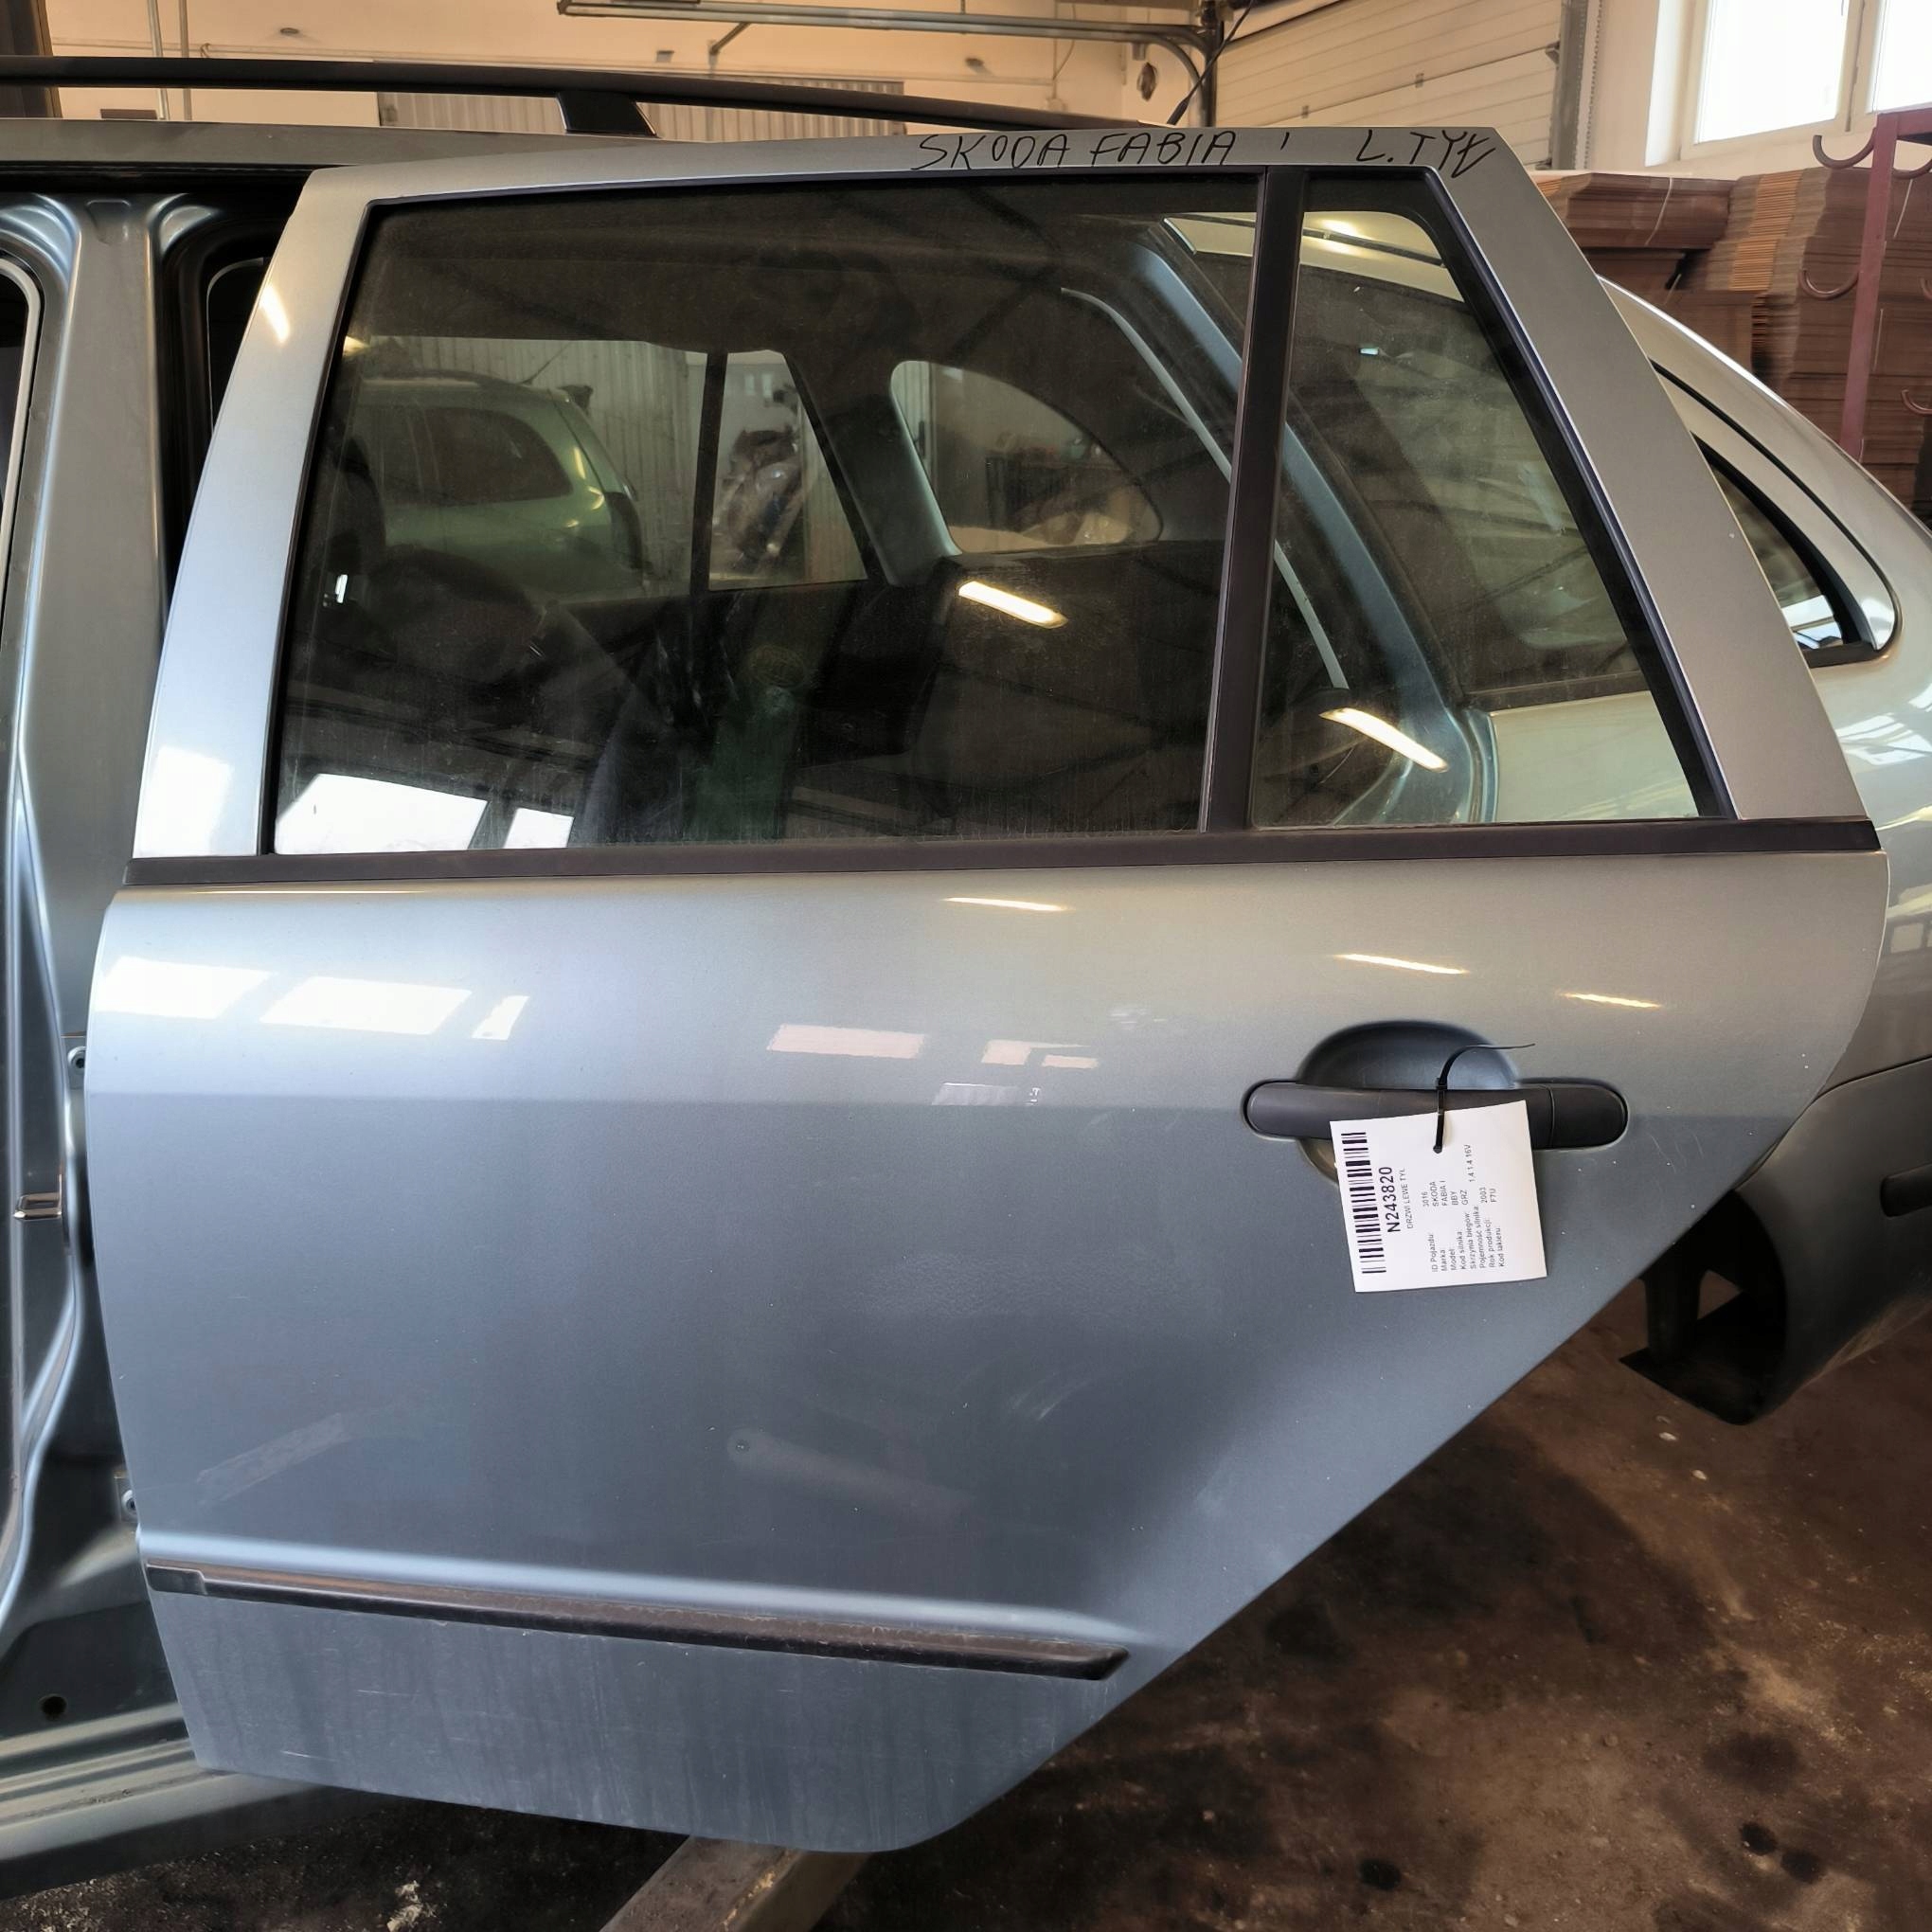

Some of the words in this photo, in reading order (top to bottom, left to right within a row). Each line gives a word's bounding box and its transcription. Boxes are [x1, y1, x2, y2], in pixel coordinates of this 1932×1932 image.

[911, 134, 1070, 170] SKODA
[1089, 132, 1237, 168] FABIA
[1379, 1167, 1400, 1232] N243820
[1430, 1182, 1439, 1207] SKODA
